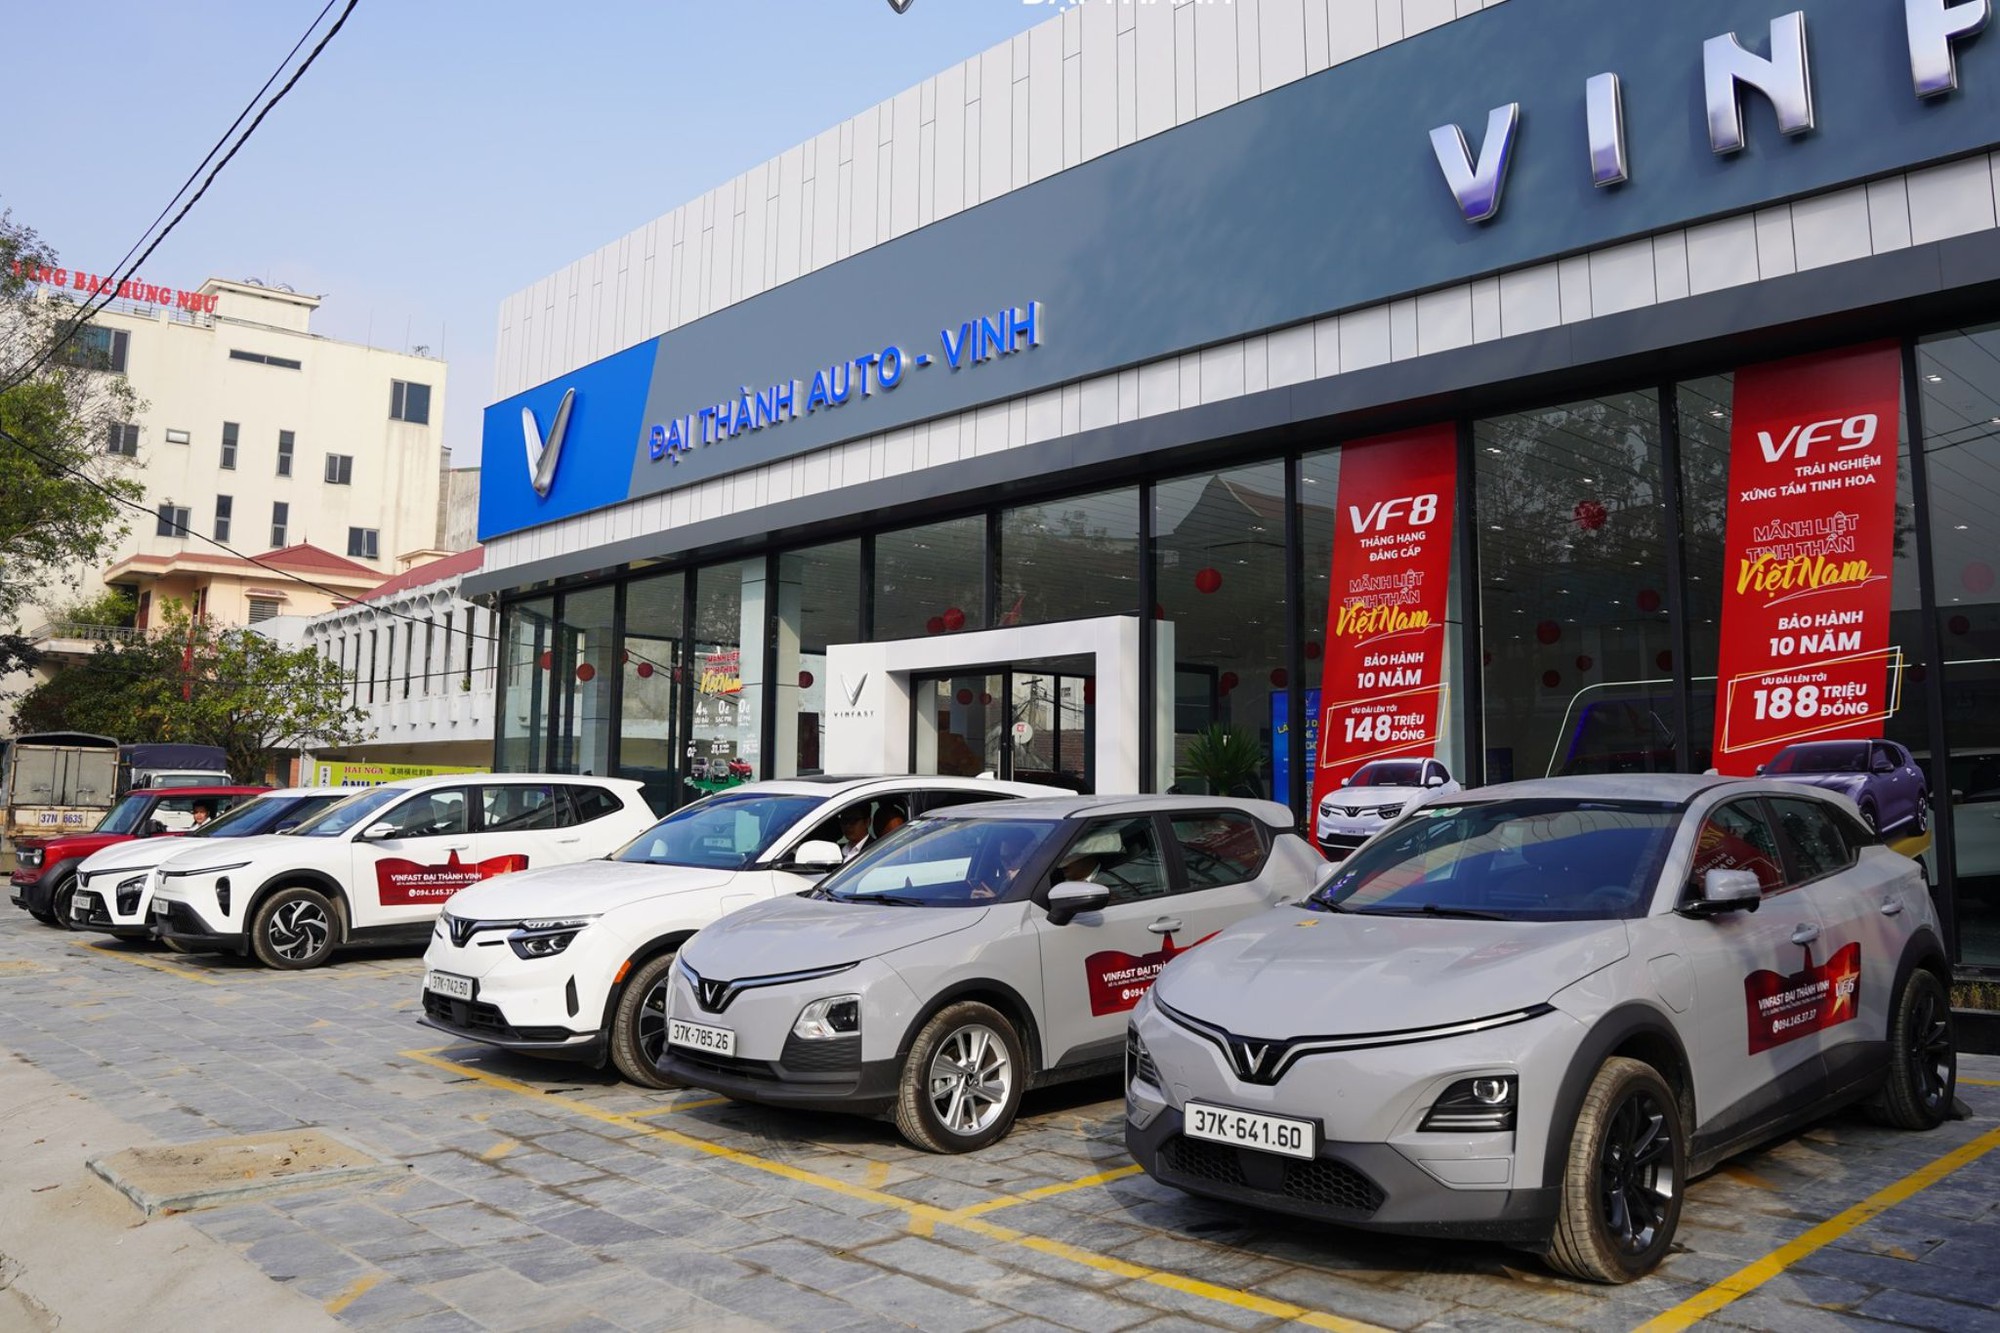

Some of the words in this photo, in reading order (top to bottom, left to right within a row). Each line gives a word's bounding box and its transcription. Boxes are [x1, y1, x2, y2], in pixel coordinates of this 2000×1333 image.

[177, 290, 219, 313] NHƯ
[648, 414, 695, 463] ĐẠI
[699, 387, 801, 444] THÀNH
[807, 345, 910, 412] AUTO
[941, 301, 1042, 369] VINH
[1757, 413, 1878, 463] VF9
[1794, 461, 1825, 477] TRẢI
[1829, 454, 1881, 472] NGHIỆM
[1740, 486, 1777, 502] XỨNG
[1810, 476, 1841, 492] TINH
[1845, 473, 1876, 487] HOA
[1349, 494, 1438, 534] VF8
[1397, 531, 1426, 544] HẠNG
[1753, 519, 1813, 542] MÃNH
[1815, 511, 1859, 536] LIỆT
[1401, 544, 1421, 557] CẤP
[1796, 533, 1855, 557] THẦN
[1349, 574, 1392, 593] MÃNH
[1393, 569, 1424, 588] LIỆT
[1778, 613, 1812, 630] BẢO
[1815, 610, 1863, 627] HÀNH
[1770, 636, 1794, 656] 10
[1800, 629, 1861, 654] NĂM
[1364, 653, 1387, 667] BẢO
[1390, 651, 1424, 665] HÀNH
[1357, 672, 1375, 688] 10
[1378, 667, 1422, 687] NĂM
[1753, 685, 1819, 720] 188
[1822, 681, 1867, 700] TRIỆU
[834, 710, 874, 718] VINFAST
[1344, 714, 1392, 743] 148
[1393, 712, 1424, 728] TRIỆU
[1103, 969, 1136, 982] VINFAST
[674, 1024, 728, 1050] 37K-785.26
[1195, 1110, 1301, 1150] 37K-641.60
